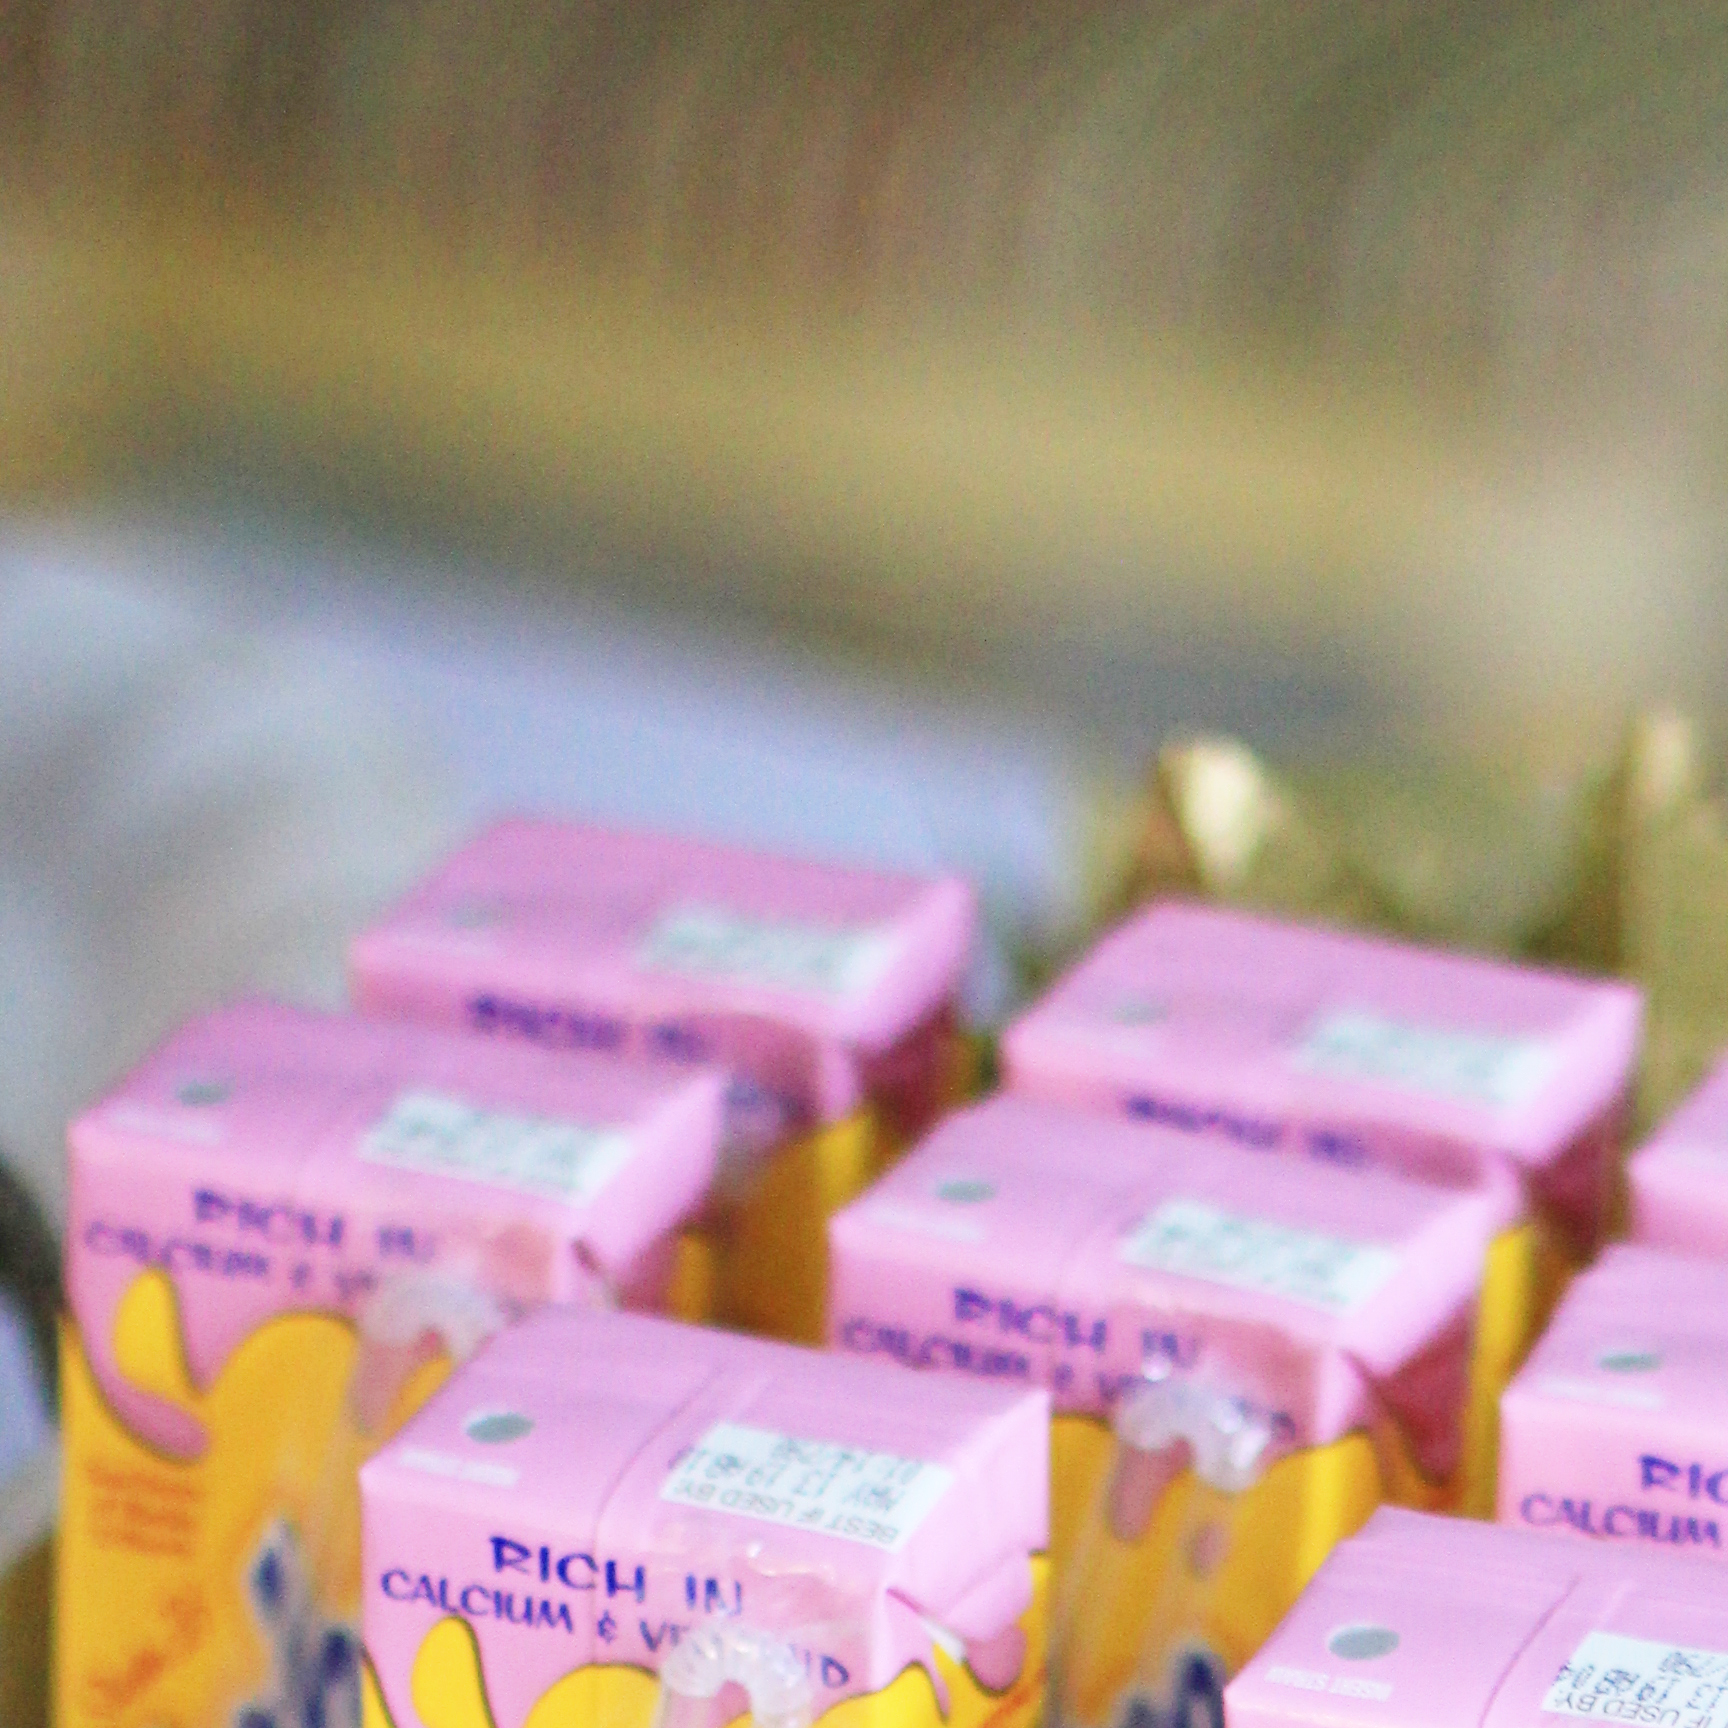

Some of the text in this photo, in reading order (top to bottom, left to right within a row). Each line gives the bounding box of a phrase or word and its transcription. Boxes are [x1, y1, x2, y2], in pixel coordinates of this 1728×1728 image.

[1520, 1494, 1722, 1549] CALCIUM
[381, 1568, 574, 1634] CALCIUM
[490, 1535, 743, 1617] RICH IN
[1602, 1699, 1681, 1727] USED
